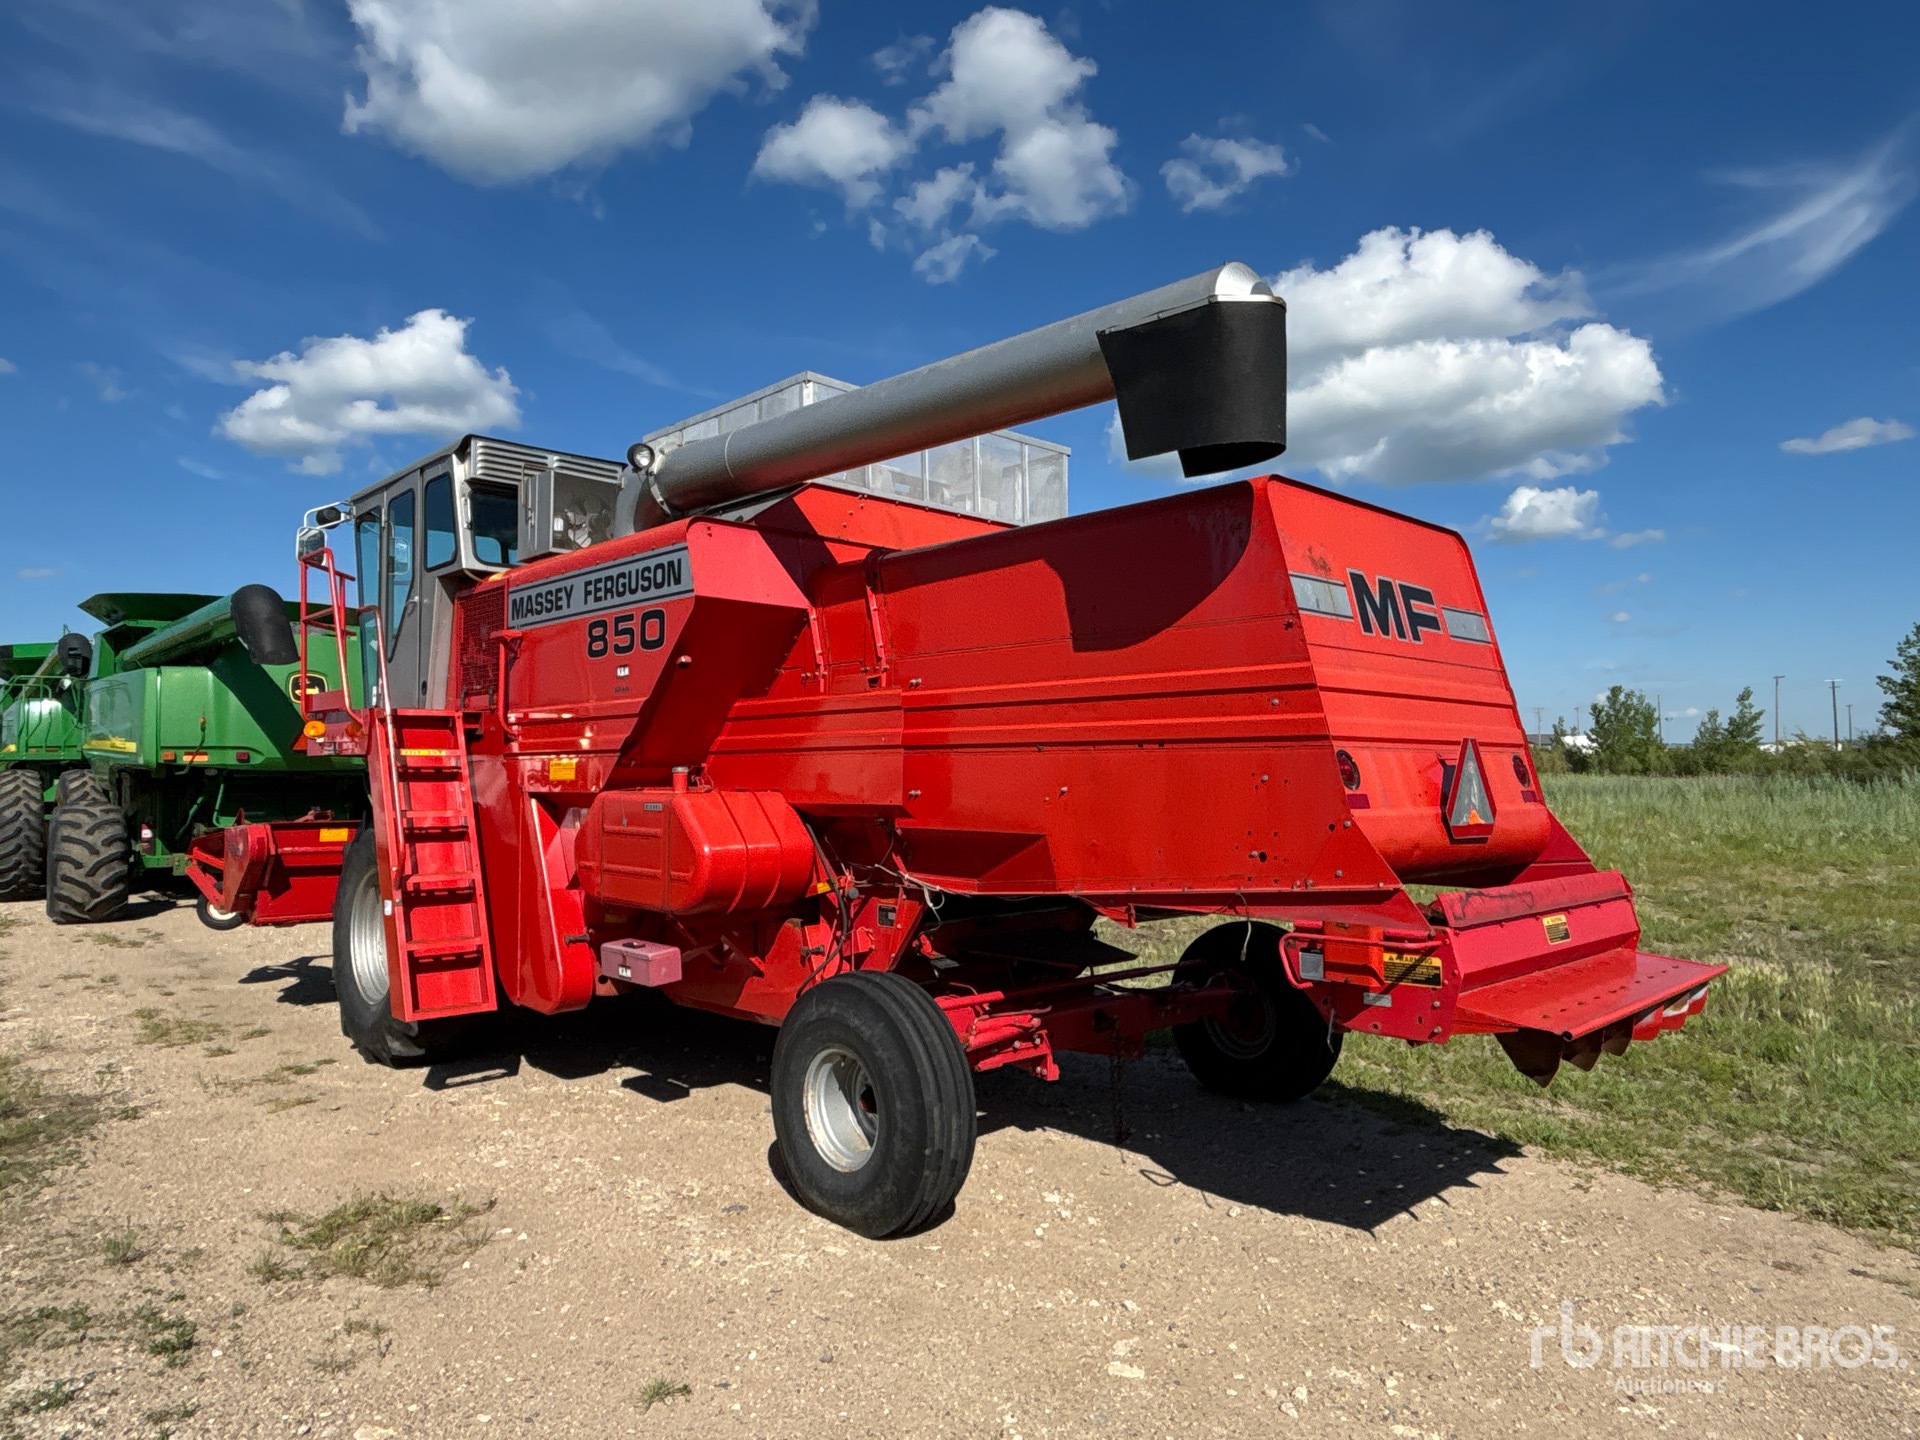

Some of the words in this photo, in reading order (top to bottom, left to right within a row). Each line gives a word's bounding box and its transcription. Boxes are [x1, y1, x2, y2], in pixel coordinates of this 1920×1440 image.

[511, 584, 574, 621] MASSEY
[584, 558, 682, 605] FERGUSON
[1348, 570, 1442, 643] MF
[588, 609, 665, 657] 850
